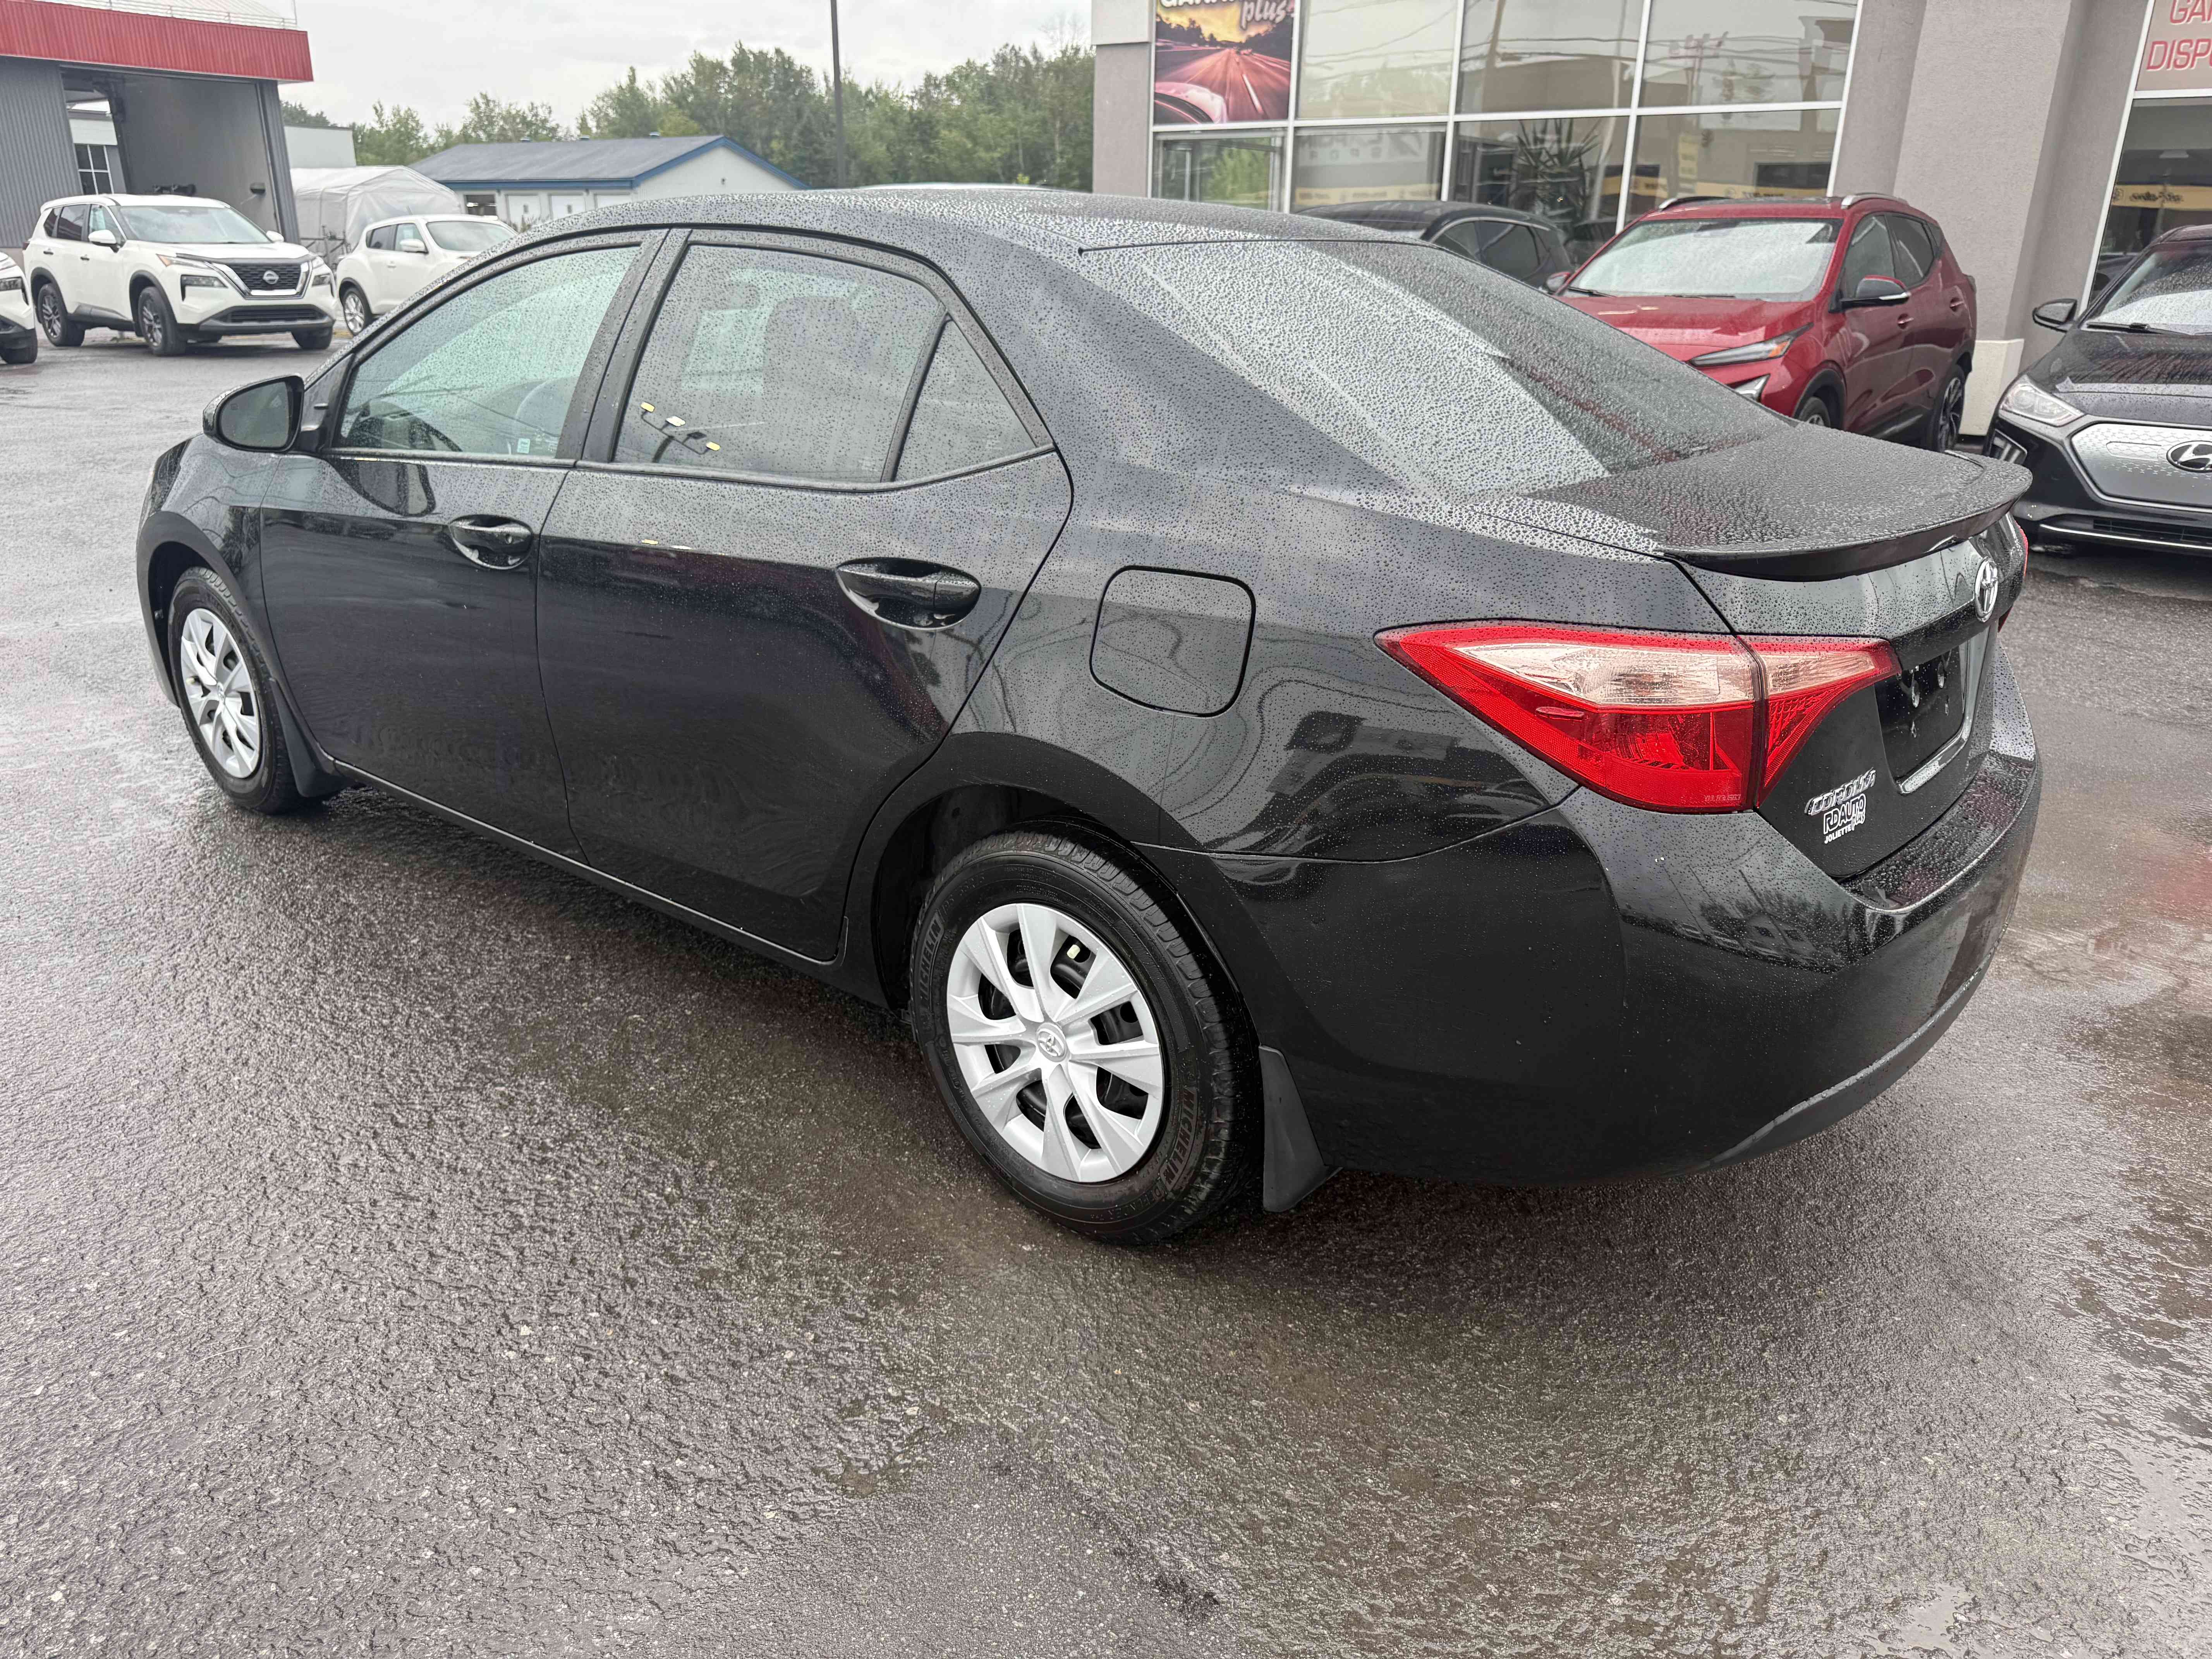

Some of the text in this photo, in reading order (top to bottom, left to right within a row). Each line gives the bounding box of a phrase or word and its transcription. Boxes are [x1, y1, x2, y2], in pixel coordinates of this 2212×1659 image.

[1240, 0, 1287, 29] plus
[2170, 0, 2212, 24] GA
[2146, 38, 2212, 70] DISP
[1824, 824, 1851, 844] JOLIETTE
[1163, 1086, 1195, 1186] MICHELIN
